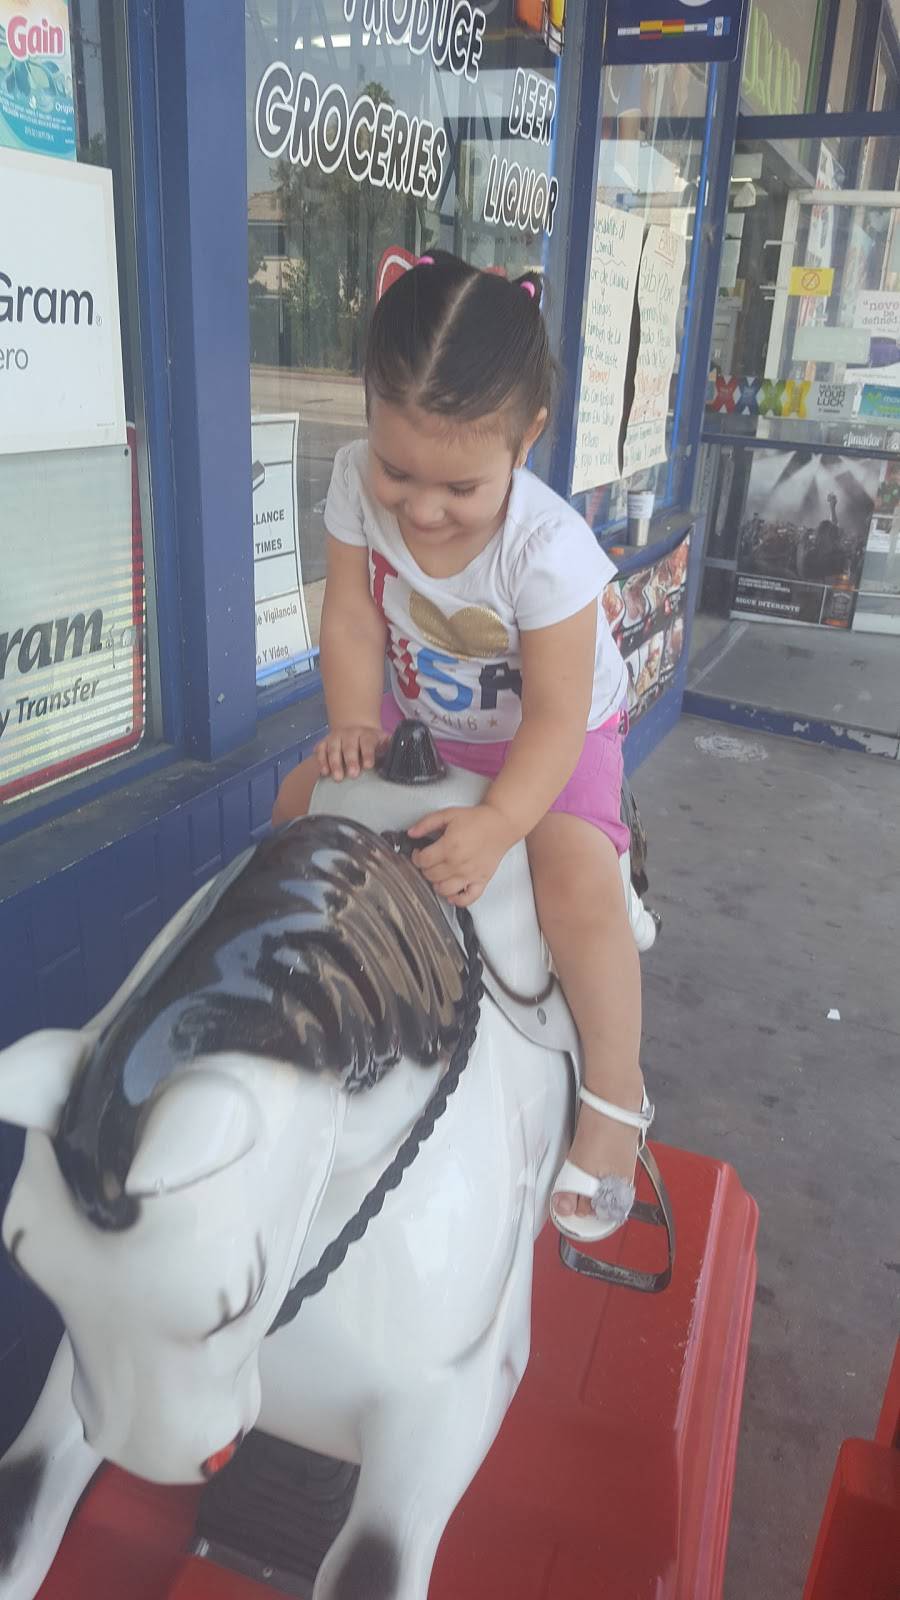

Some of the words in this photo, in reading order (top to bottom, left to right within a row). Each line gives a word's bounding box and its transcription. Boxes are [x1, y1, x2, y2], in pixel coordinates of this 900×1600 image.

[8, 15, 64, 59] Gain
[509, 67, 557, 146] BEER
[256, 61, 447, 200] GROCERIES
[483, 154, 558, 236] LIQUOR
[816, 398, 844, 408] LUCK
[819, 391, 846, 402] YOUR
[255, 537, 283, 554] TIMES
[263, 603, 298, 625] Vigilancia
[262, 648, 268, 663] Y
[269, 644, 290, 660] Video
[16, 677, 100, 724] Transfer
[429, 710, 479, 732] 2016
